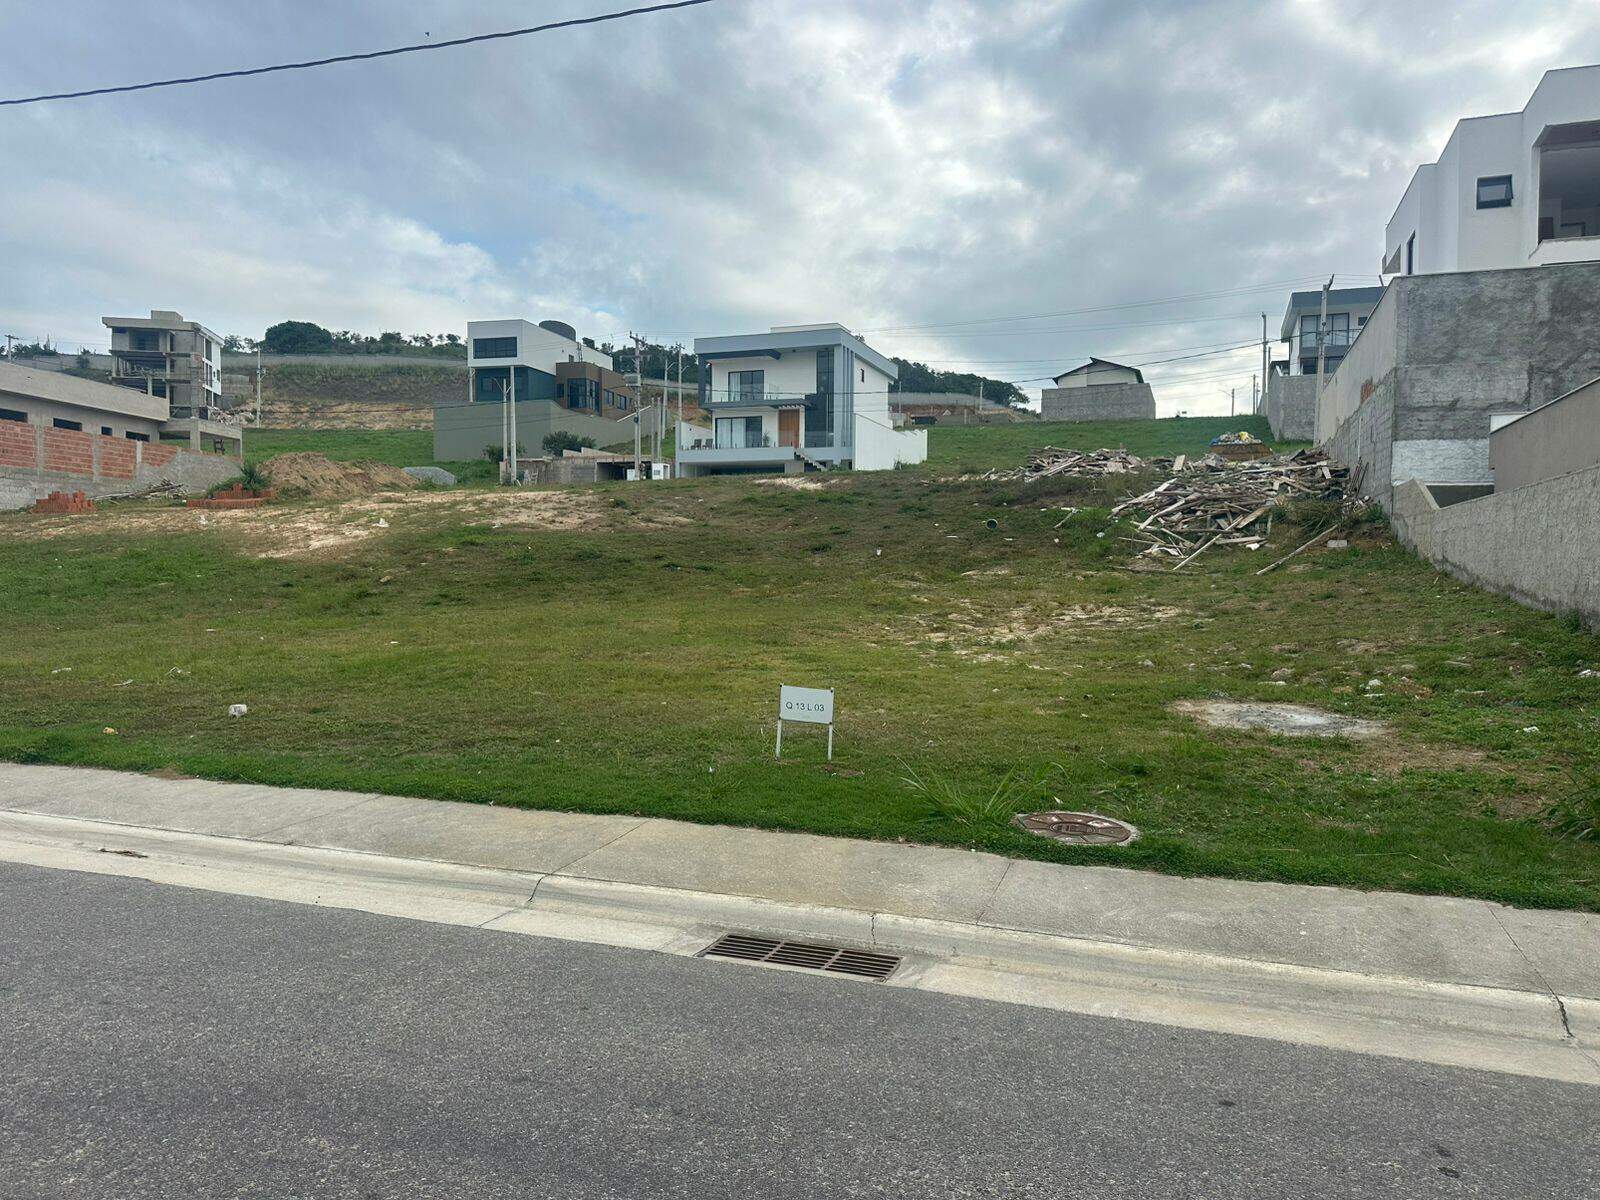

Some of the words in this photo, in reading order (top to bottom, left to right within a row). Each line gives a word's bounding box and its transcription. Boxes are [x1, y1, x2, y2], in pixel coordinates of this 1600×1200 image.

[786, 702, 793, 710] Q
[796, 702, 806, 710] 13
[814, 704, 825, 712] 03
